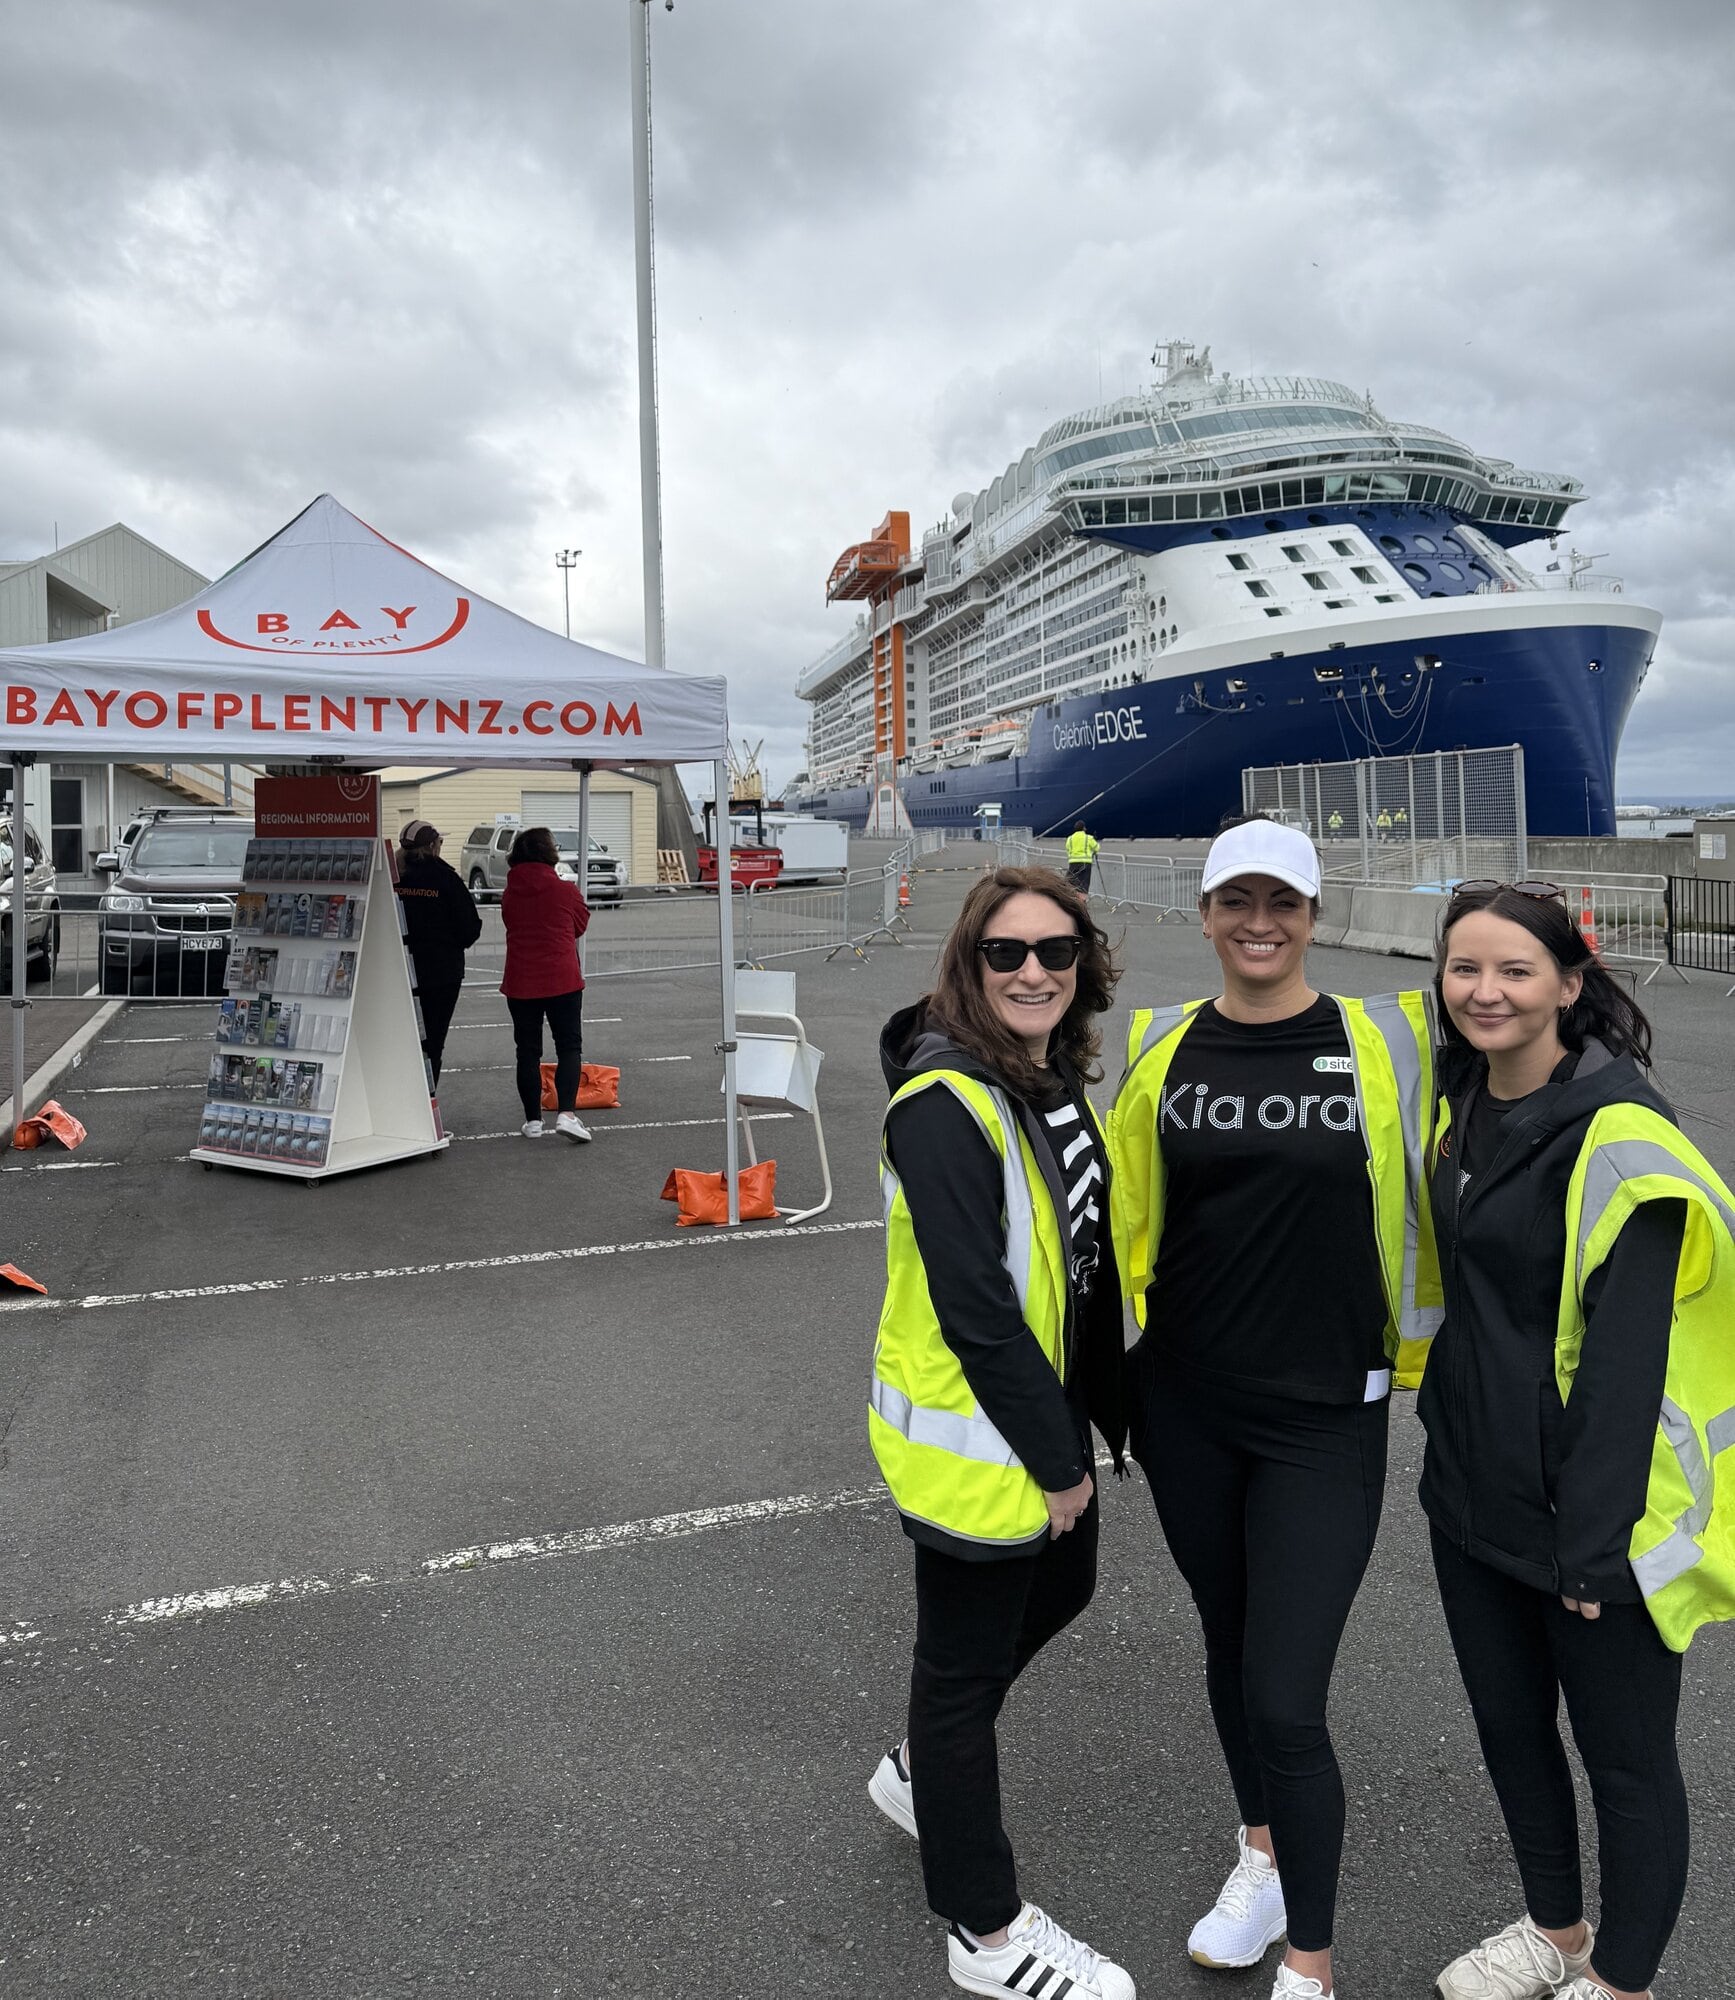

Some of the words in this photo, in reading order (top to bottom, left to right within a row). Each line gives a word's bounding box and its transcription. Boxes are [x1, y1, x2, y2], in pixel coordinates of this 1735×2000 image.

[257, 606, 417, 634] BAY
[271, 636, 305, 646] OF
[313, 633, 403, 648] PLENTY
[6, 686, 643, 736] BAYOFPLENTYNZ.COM
[1095, 705, 1147, 744] EDGE
[343, 778, 365, 788] BAY
[260, 813, 304, 825] REGIONAL
[306, 812, 370, 824] INFORMATION
[1161, 1083, 1245, 1133] Kia
[1257, 1094, 1358, 1133] ora
